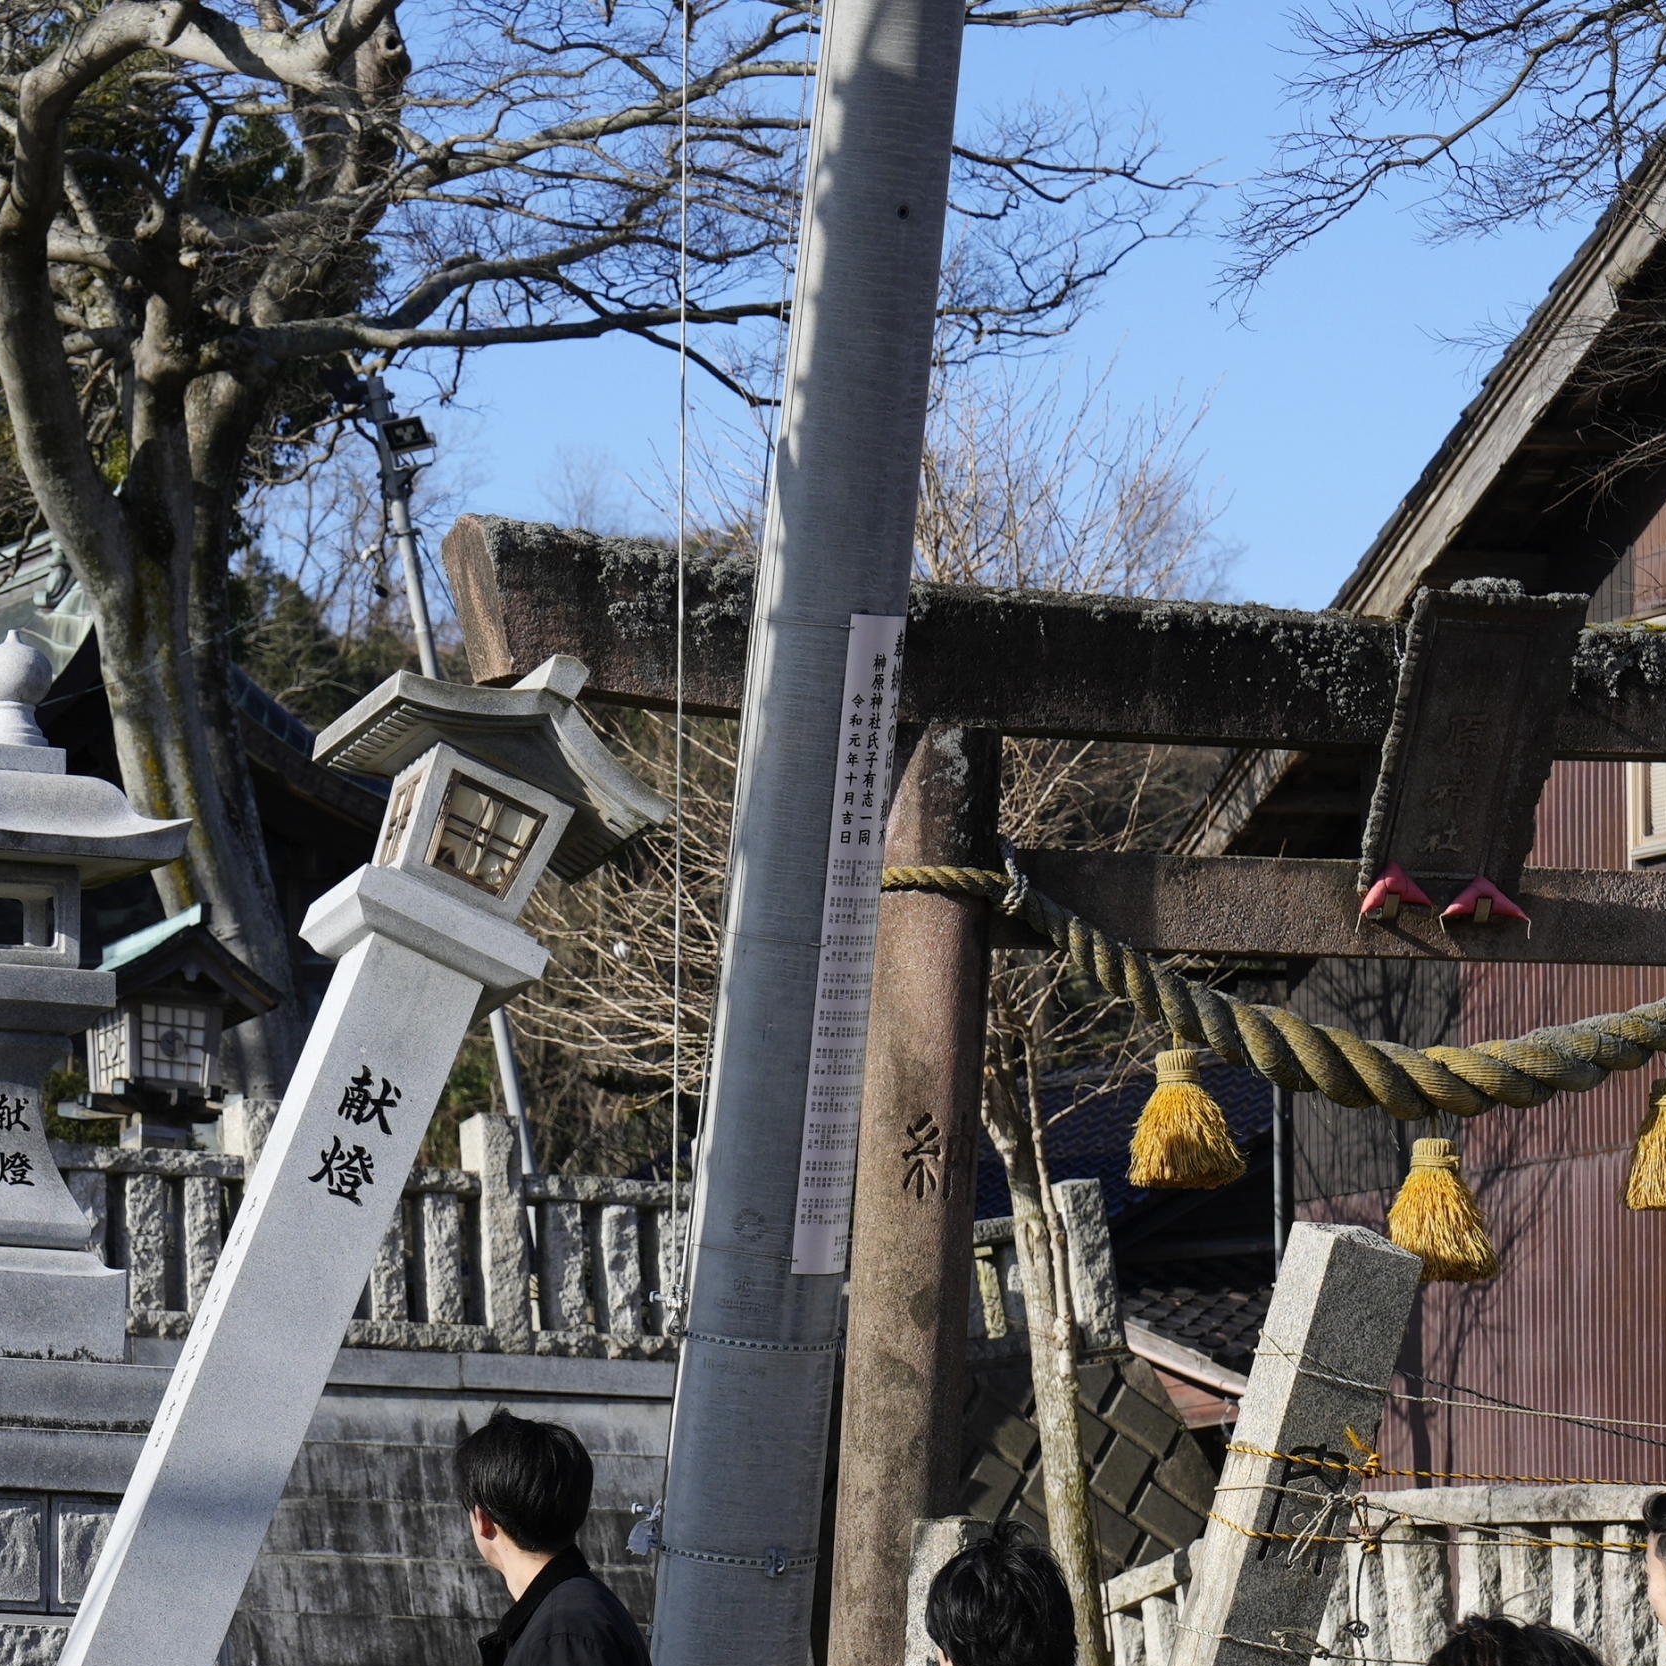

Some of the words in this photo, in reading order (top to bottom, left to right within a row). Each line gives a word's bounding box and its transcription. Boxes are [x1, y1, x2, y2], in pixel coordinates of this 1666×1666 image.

[840, 693, 865, 844] 令和元年十月吉日
[859, 653, 887, 846] 榊原神社氏子有志一同
[308, 1064, 403, 1207] 献燈
